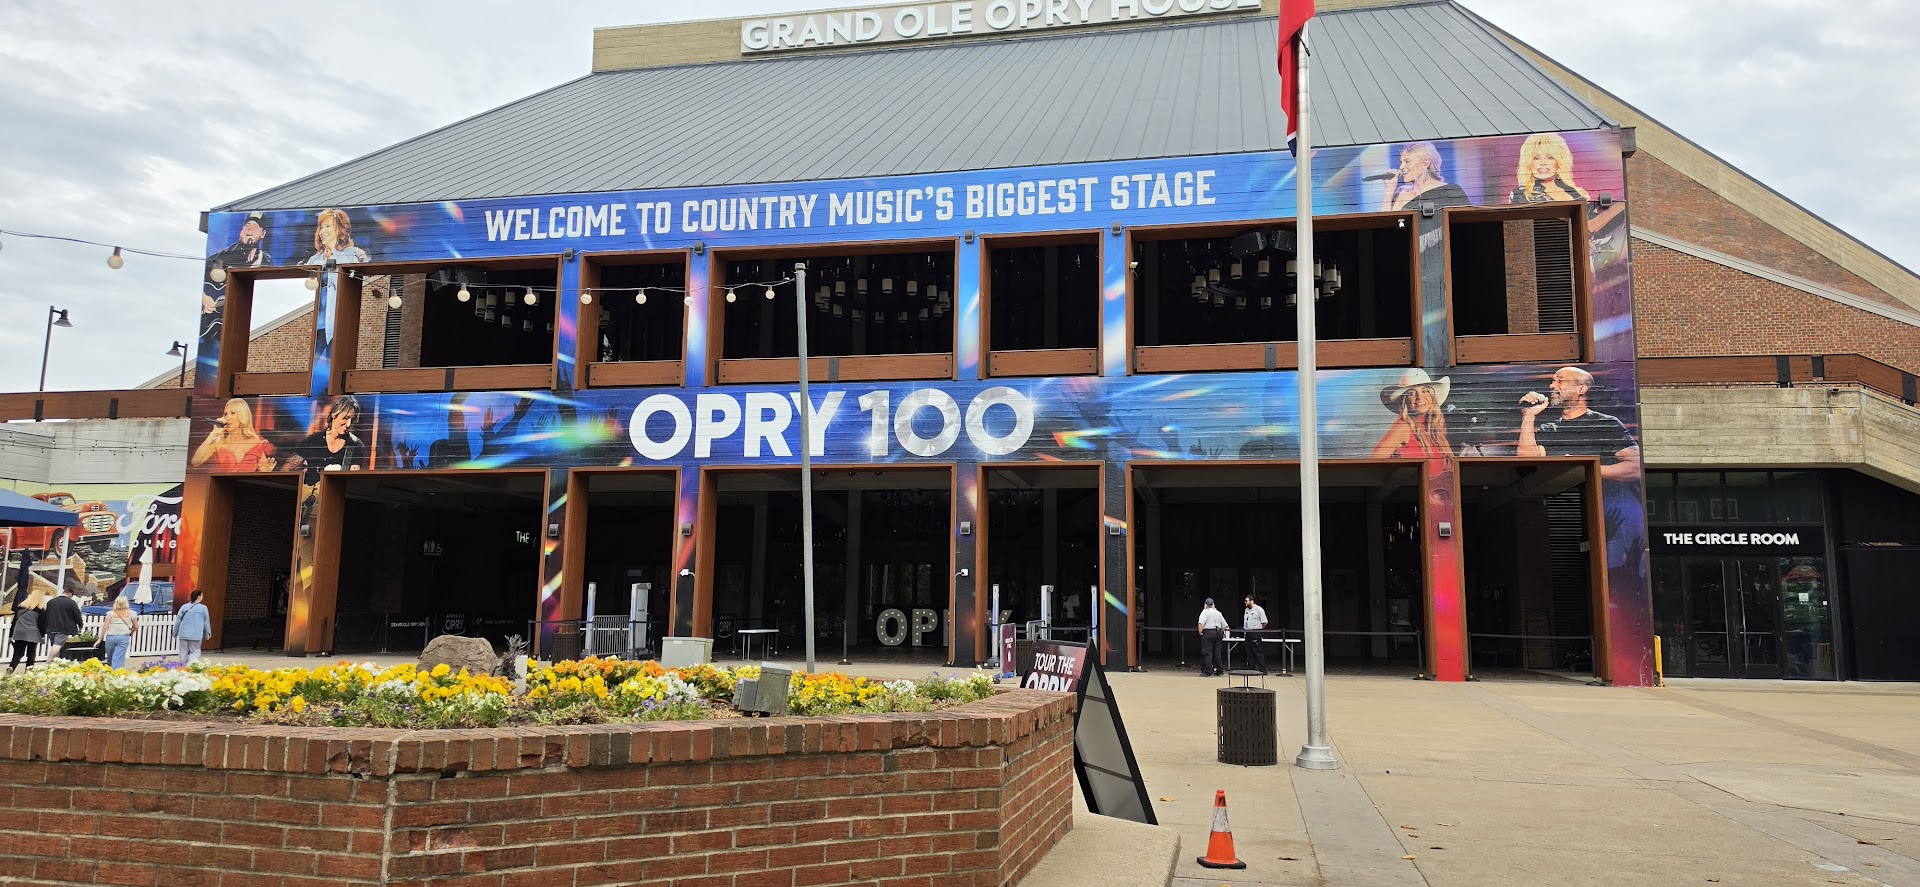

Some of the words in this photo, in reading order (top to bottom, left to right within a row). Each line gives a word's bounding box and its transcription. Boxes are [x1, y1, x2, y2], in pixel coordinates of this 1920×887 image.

[742, 11, 883, 50] GRAND
[894, 2, 973, 37] OLE
[985, 0, 1091, 30] OPRY
[485, 203, 627, 242] WELCOME
[636, 201, 672, 235] TO
[682, 194, 819, 233] COUNTRY
[828, 186, 954, 226] MUSIC'S
[966, 177, 1099, 219] BIGGEST
[1110, 170, 1216, 210] STAGE
[628, 391, 847, 460] OPRY
[858, 386, 1035, 457] 100
[120, 539, 177, 549] LOUNG
[515, 530, 530, 544] THE
[1663, 532, 1693, 545] THE
[1695, 532, 1748, 545] CIRCLE
[1750, 532, 1799, 545] ROOM
[1033, 652, 1057, 673] TOUR
[1057, 655, 1076, 676] THE
